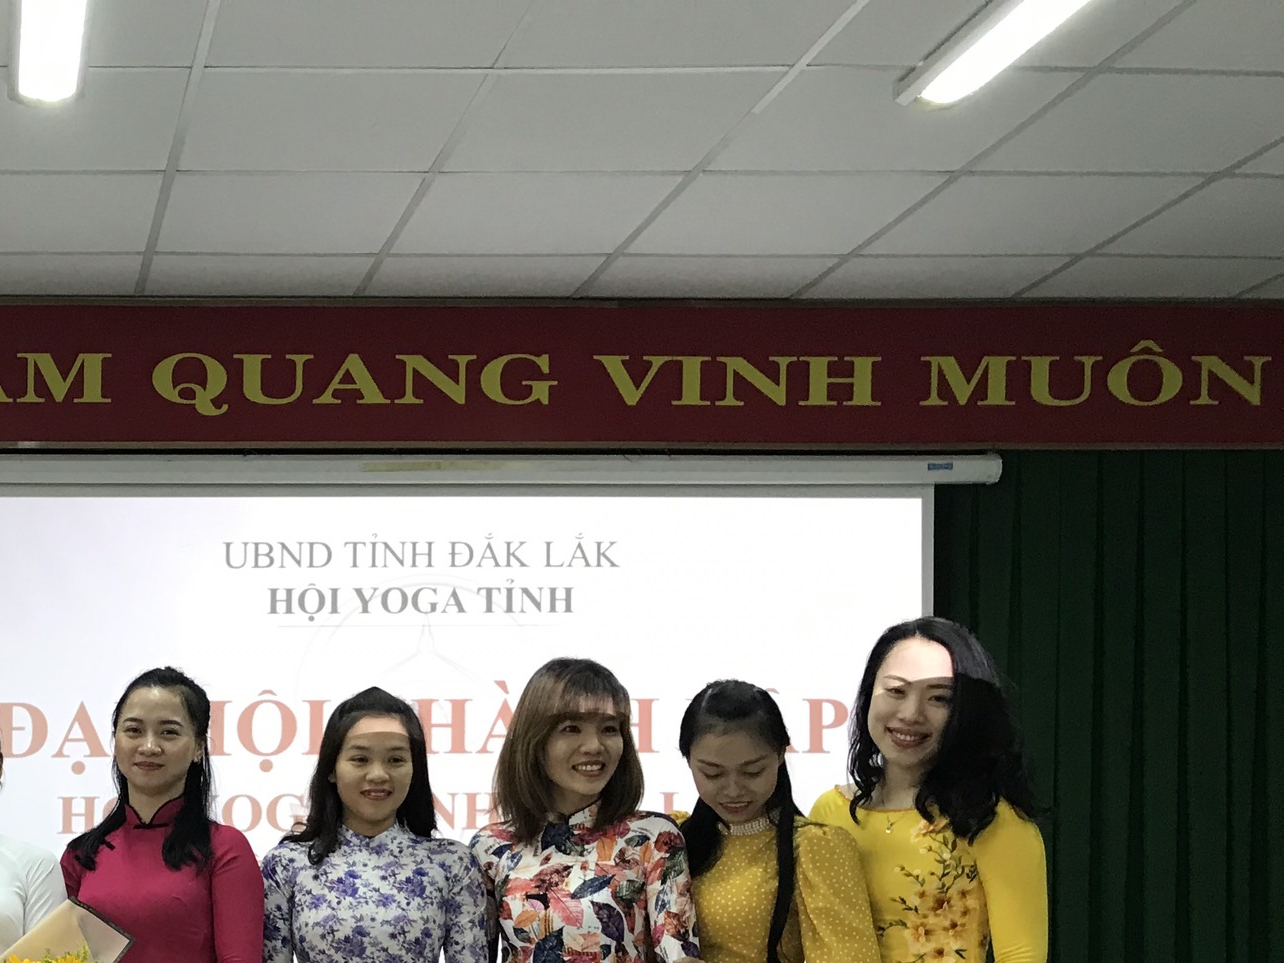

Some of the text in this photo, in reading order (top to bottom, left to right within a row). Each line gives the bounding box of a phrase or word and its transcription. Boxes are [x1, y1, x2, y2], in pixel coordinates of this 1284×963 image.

[151, 352, 558, 417] QUANG
[593, 354, 883, 407] VINH
[919, 338, 1273, 407] MUÔN
[222, 532, 621, 570] UBND TỈNH ĐẮK LẮK
[266, 578, 576, 622] HỘI YOGA TỈNH
